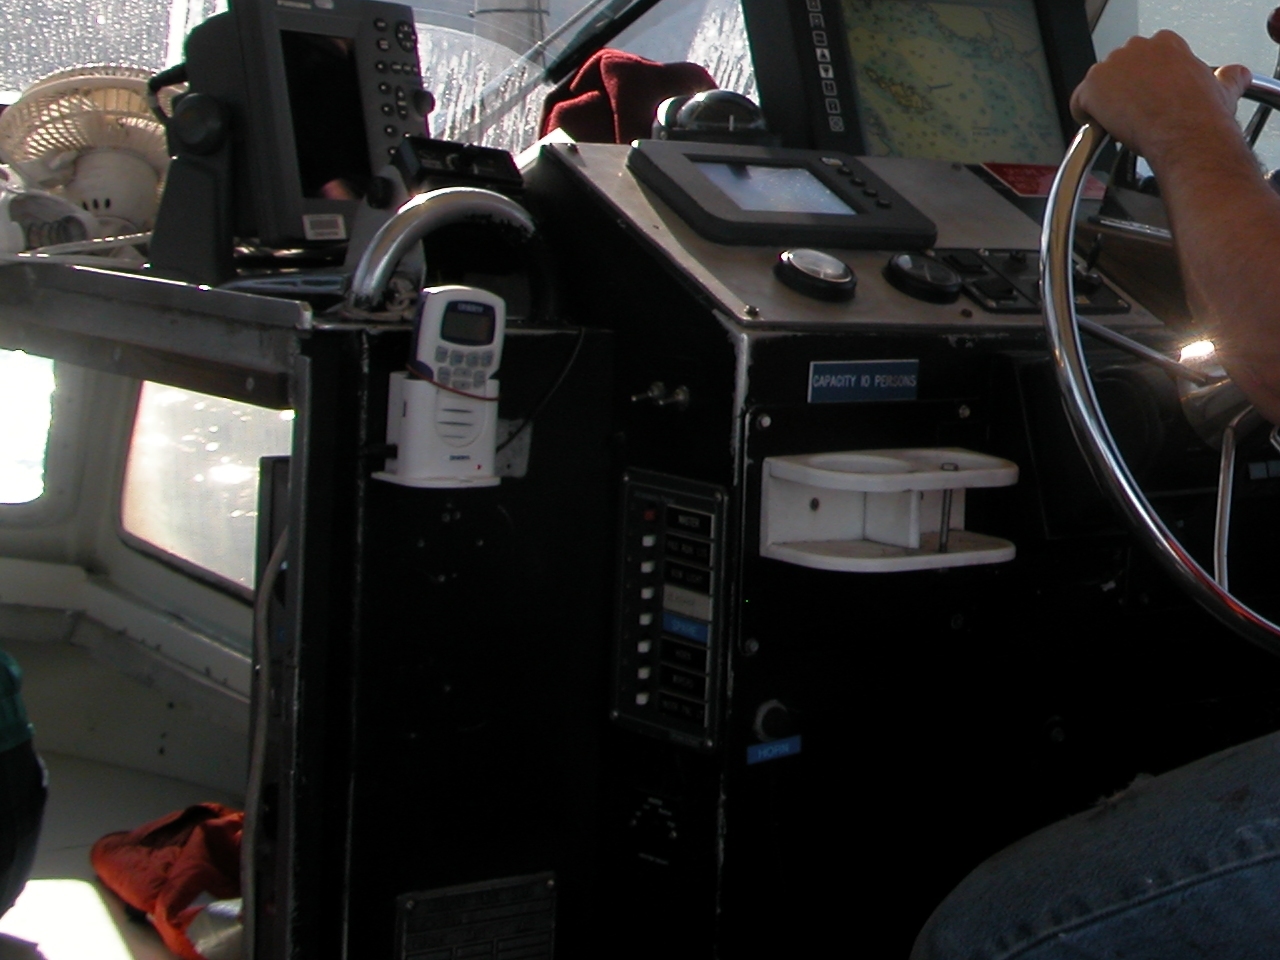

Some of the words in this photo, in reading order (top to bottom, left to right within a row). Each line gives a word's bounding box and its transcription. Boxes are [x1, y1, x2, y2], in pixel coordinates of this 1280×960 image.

[812, 374, 857, 387] CAPACITY
[860, 374, 871, 387] 10
[874, 373, 918, 387] PERSONS
